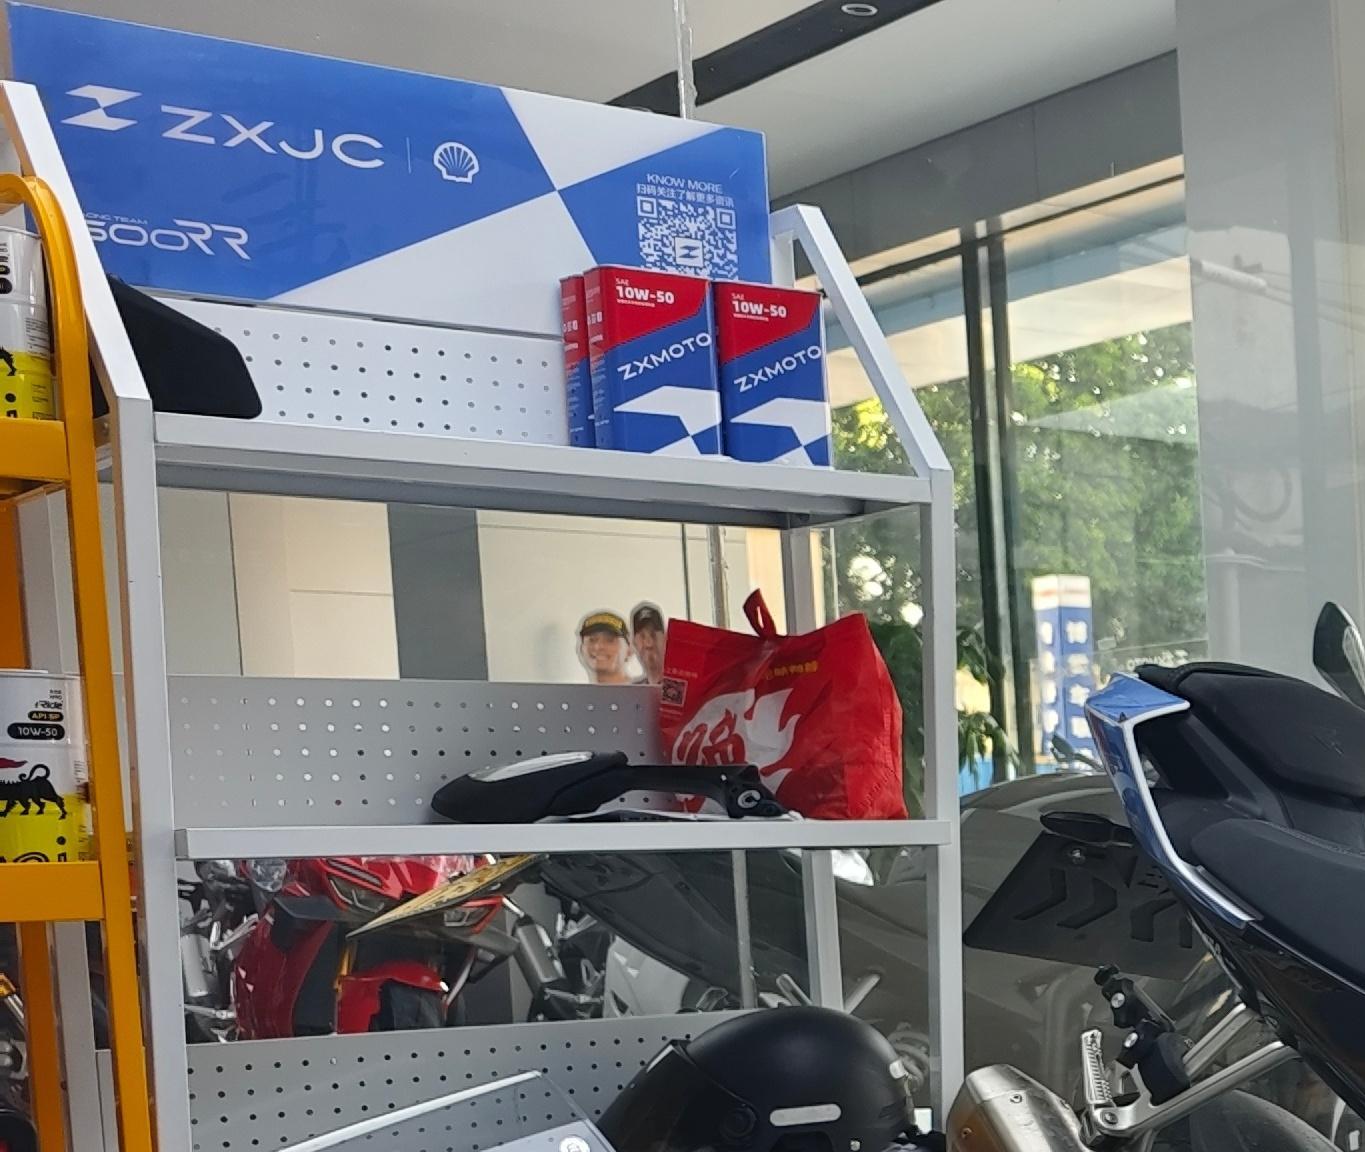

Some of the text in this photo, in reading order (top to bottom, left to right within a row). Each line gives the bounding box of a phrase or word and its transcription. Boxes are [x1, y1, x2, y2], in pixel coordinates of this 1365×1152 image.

[160, 105, 385, 169] ZXJC
[647, 173, 723, 194] KNOW MORE
[114, 215, 148, 225] TEAM
[615, 278, 629, 287] SAE
[616, 286, 675, 305] 10W-50
[731, 293, 745, 301] SAE
[732, 300, 787, 318] 10W-50
[617, 332, 713, 381] ZXMOTO
[734, 345, 822, 393] ZXMOTO
[18, 725, 58, 737] 10W-50
